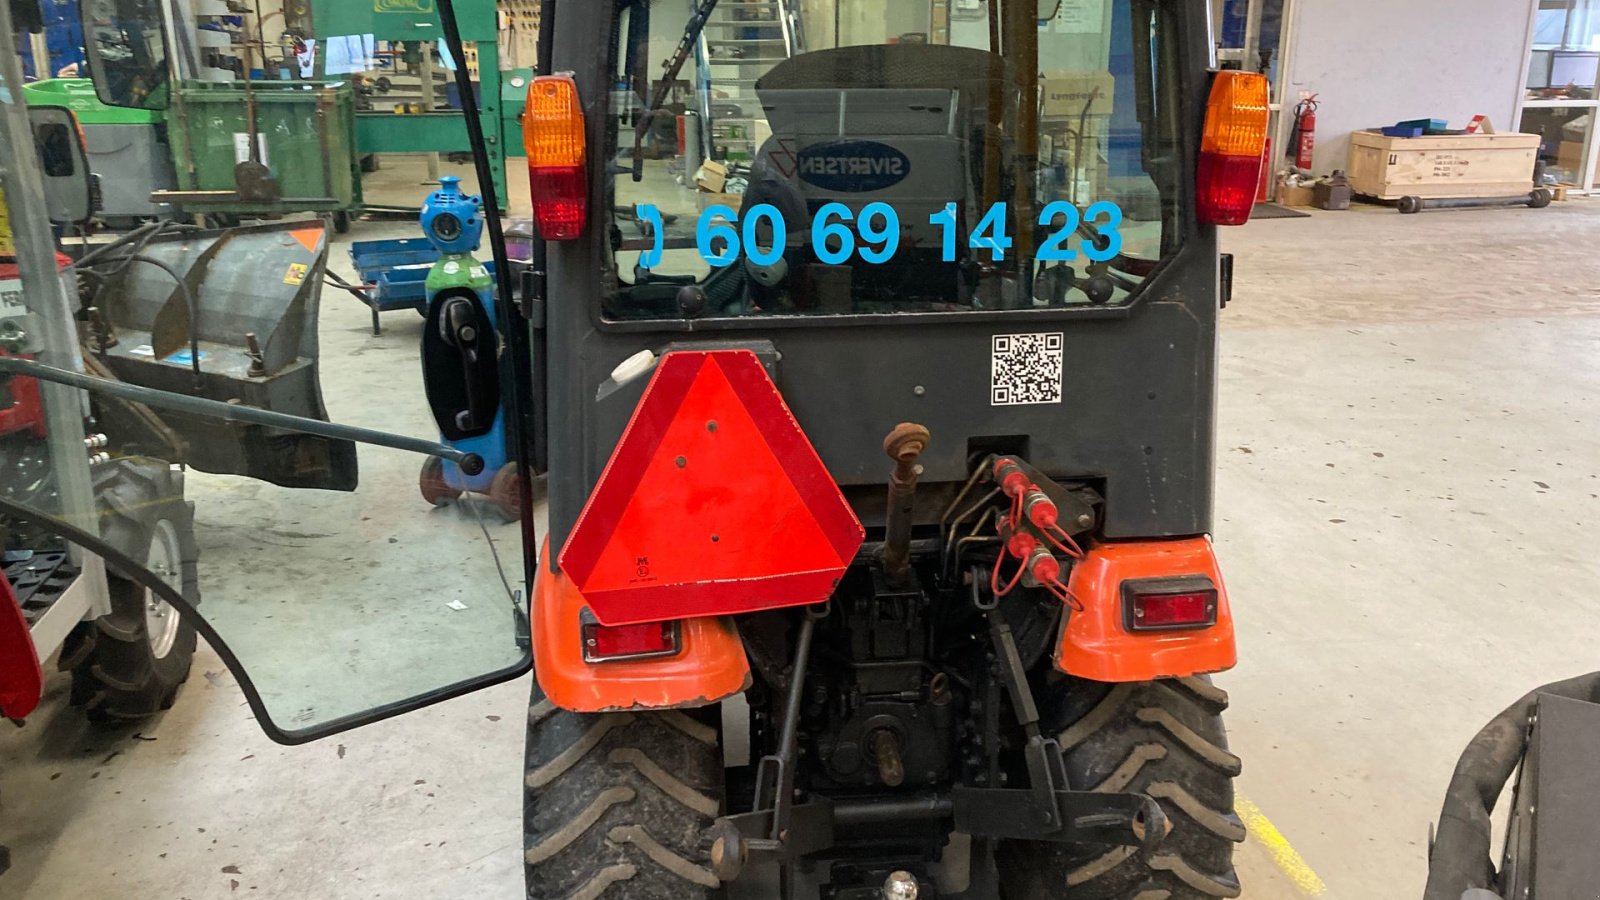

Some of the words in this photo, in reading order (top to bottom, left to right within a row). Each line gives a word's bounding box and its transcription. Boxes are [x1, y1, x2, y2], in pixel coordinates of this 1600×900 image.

[695, 203, 787, 269] 60
[811, 202, 900, 265] 69
[929, 201, 1012, 263] 14
[1035, 200, 1123, 263] 23
